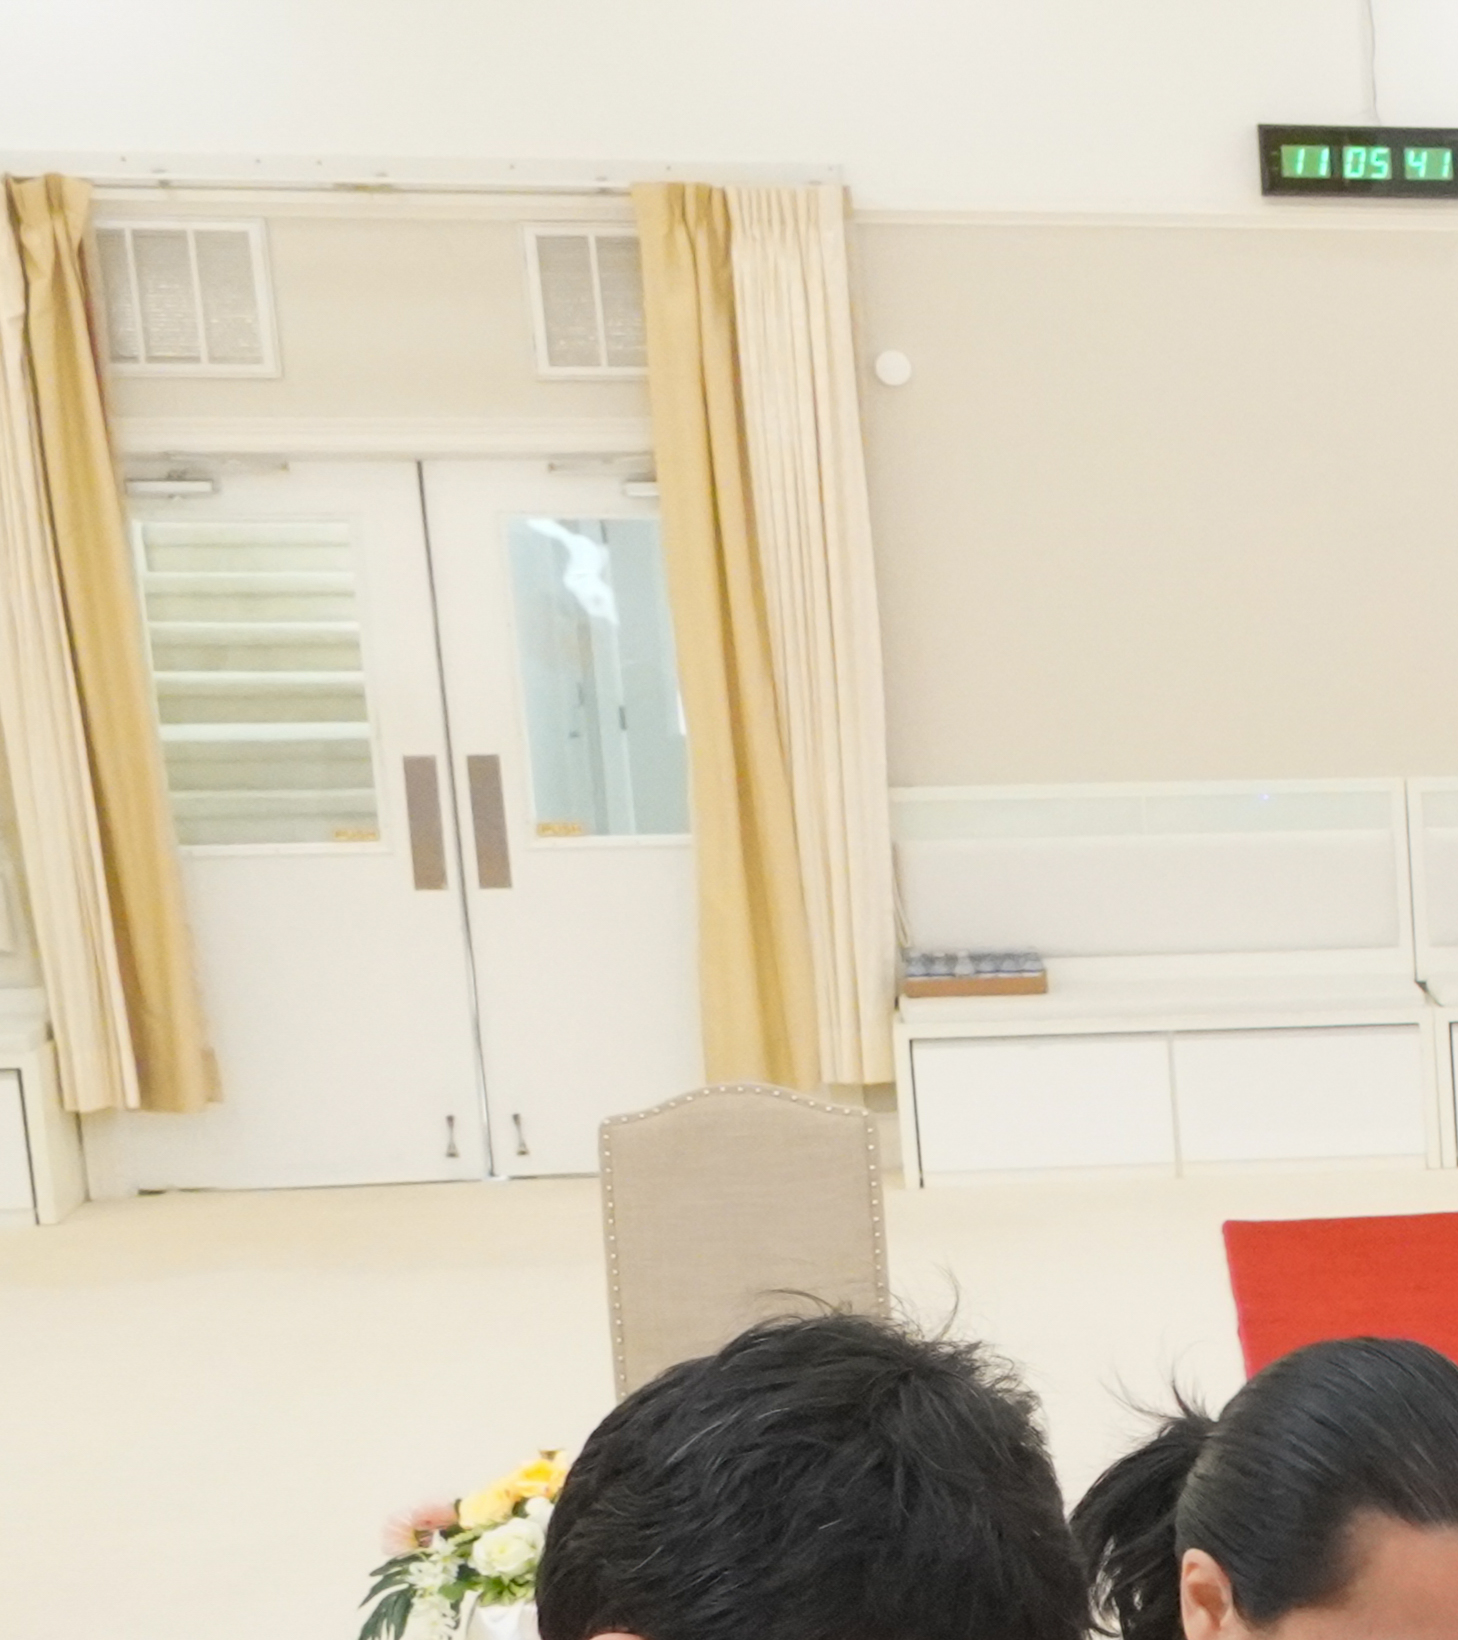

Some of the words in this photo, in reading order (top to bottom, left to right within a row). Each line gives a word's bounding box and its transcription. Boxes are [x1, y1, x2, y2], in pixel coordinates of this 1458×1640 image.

[1295, 147, 1329, 176] 11
[1343, 147, 1389, 179] 05
[1406, 150, 1451, 178] 41
